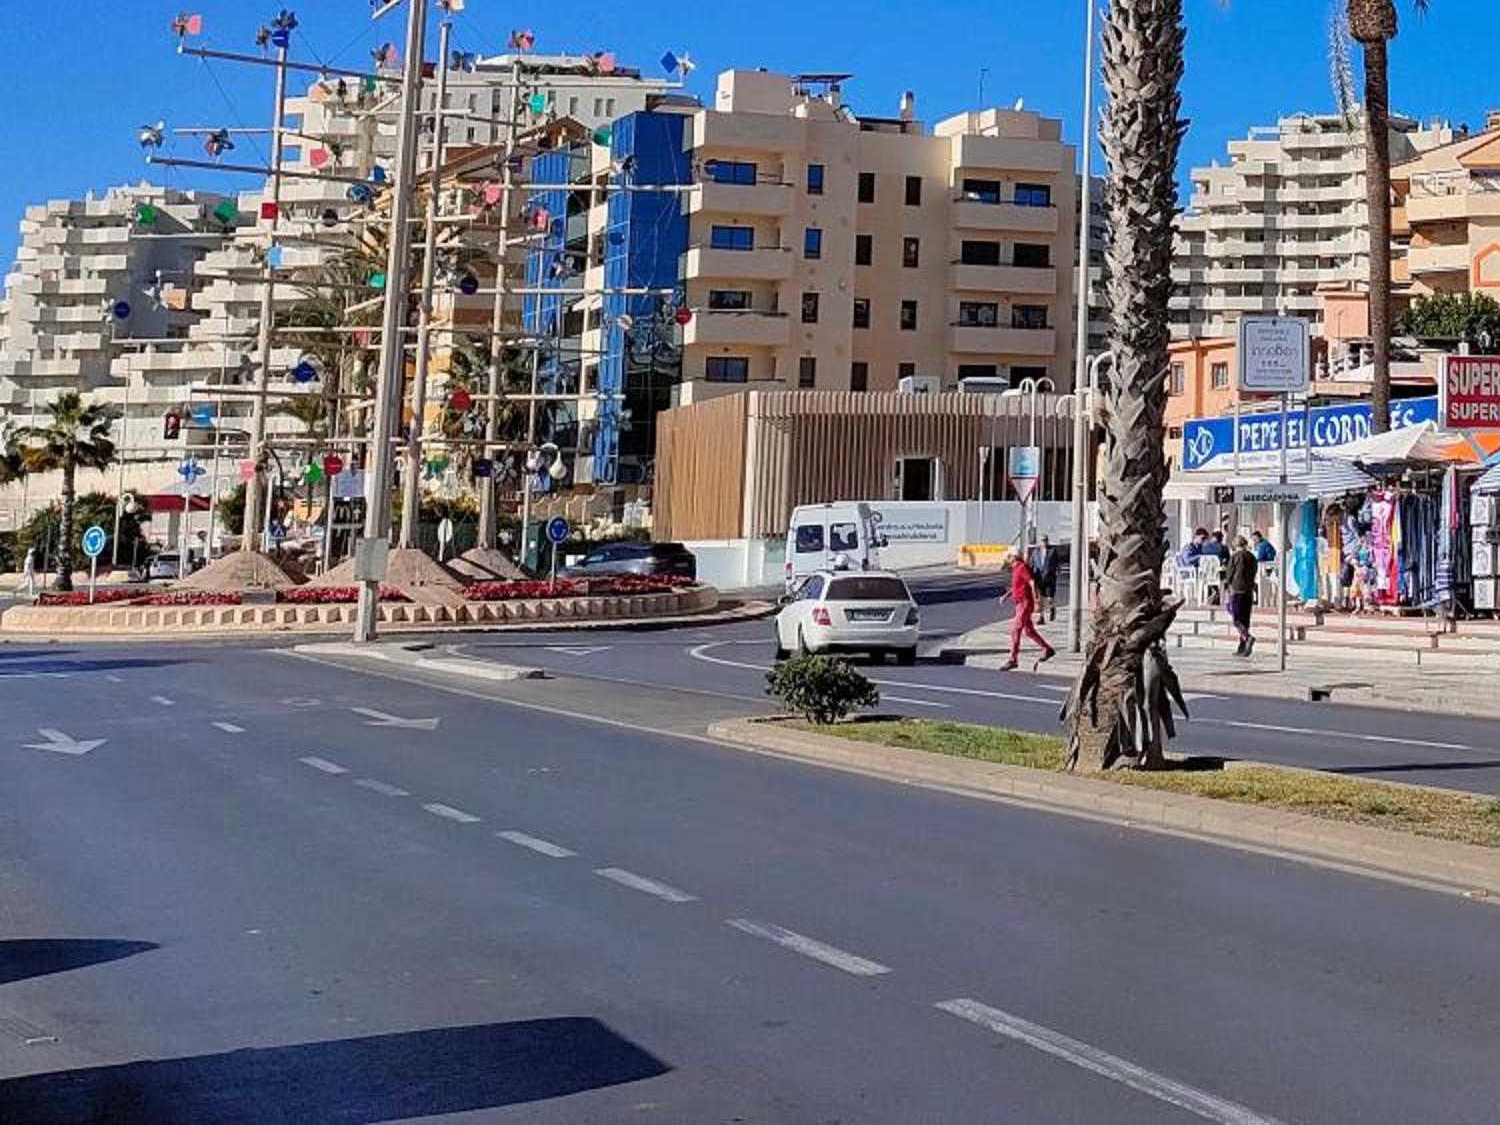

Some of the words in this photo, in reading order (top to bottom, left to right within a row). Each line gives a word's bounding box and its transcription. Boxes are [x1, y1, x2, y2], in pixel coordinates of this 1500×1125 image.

[1240, 421, 1279, 451] PEPE
[1287, 417, 1307, 447] EL
[1313, 404, 1415, 446] CORDÉS
